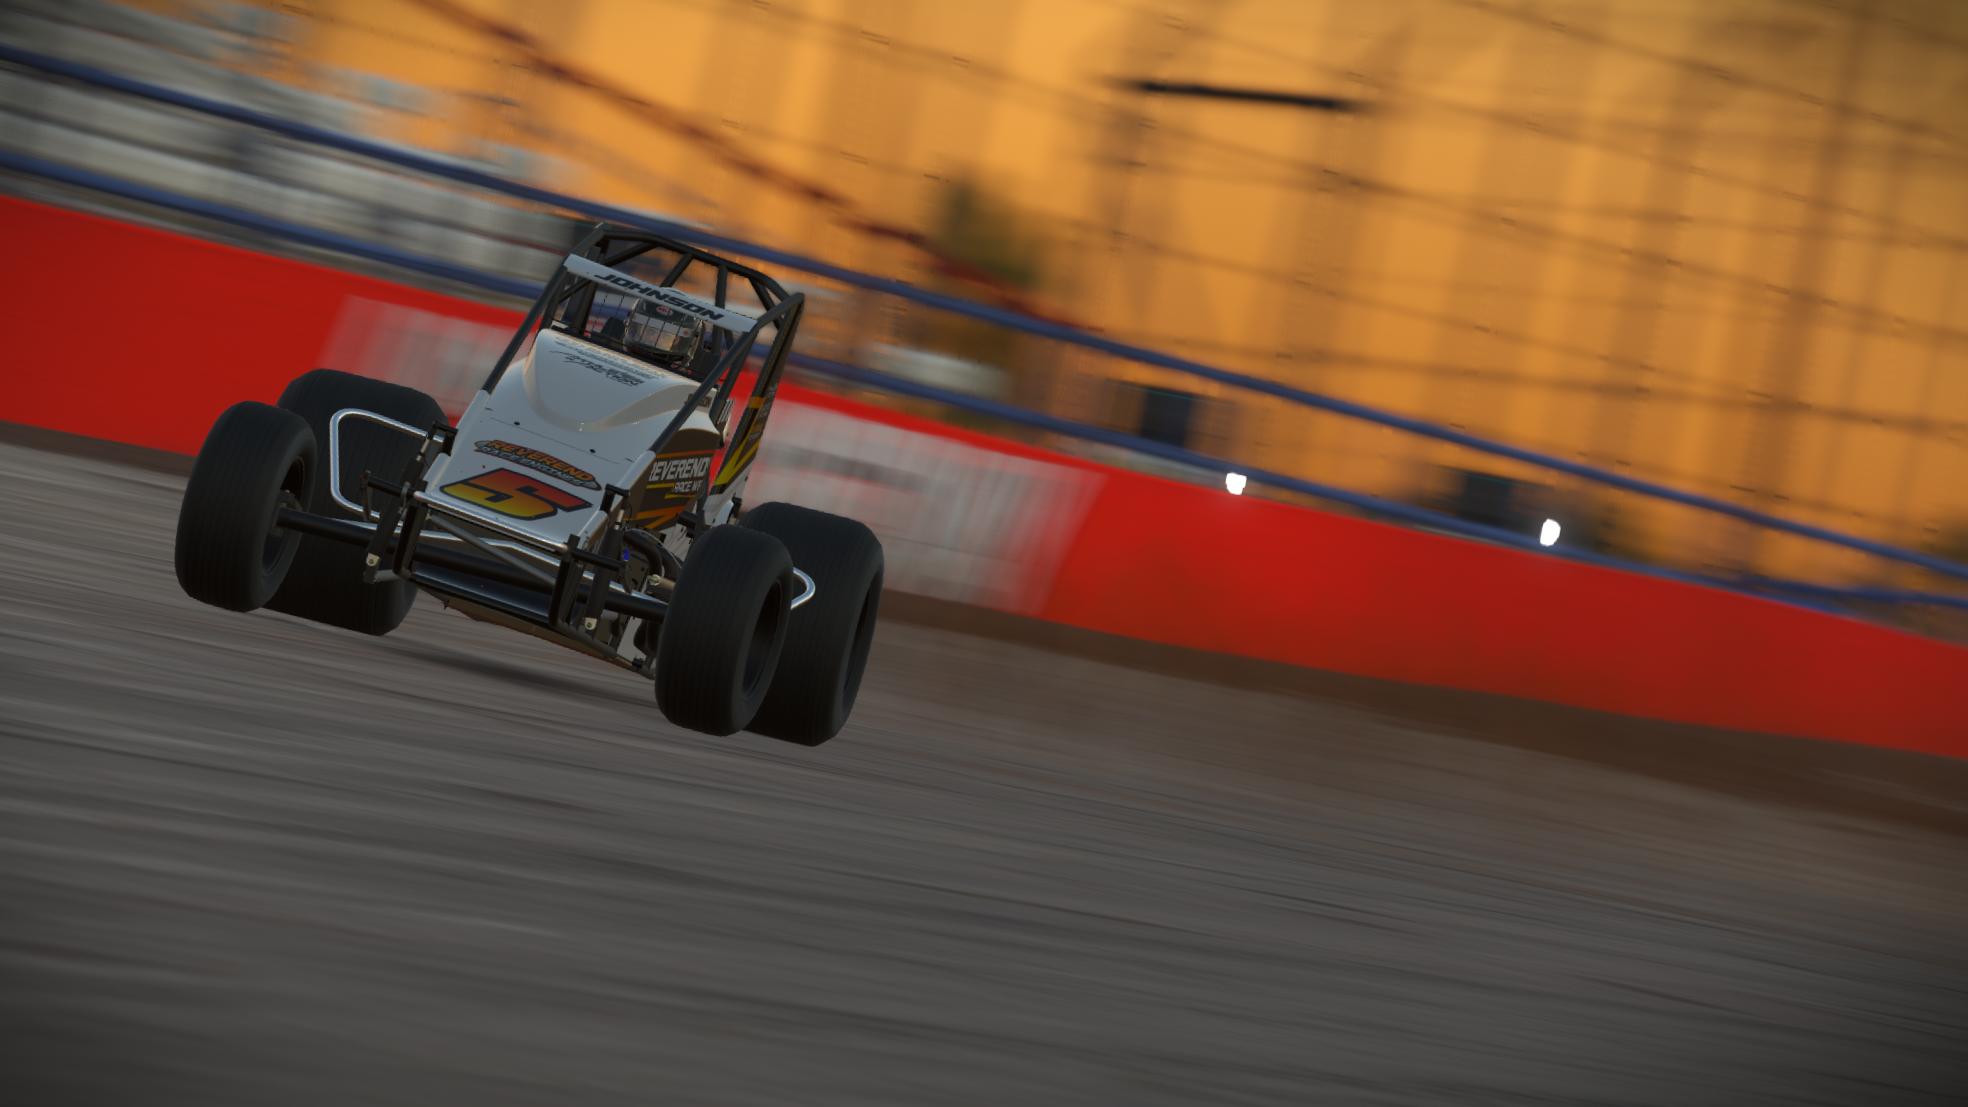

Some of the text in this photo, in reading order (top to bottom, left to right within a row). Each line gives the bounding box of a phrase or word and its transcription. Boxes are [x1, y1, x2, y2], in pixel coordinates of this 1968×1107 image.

[594, 274, 724, 320] JOHNSON
[485, 439, 596, 481] REVEREND
[439, 467, 593, 520] 5
